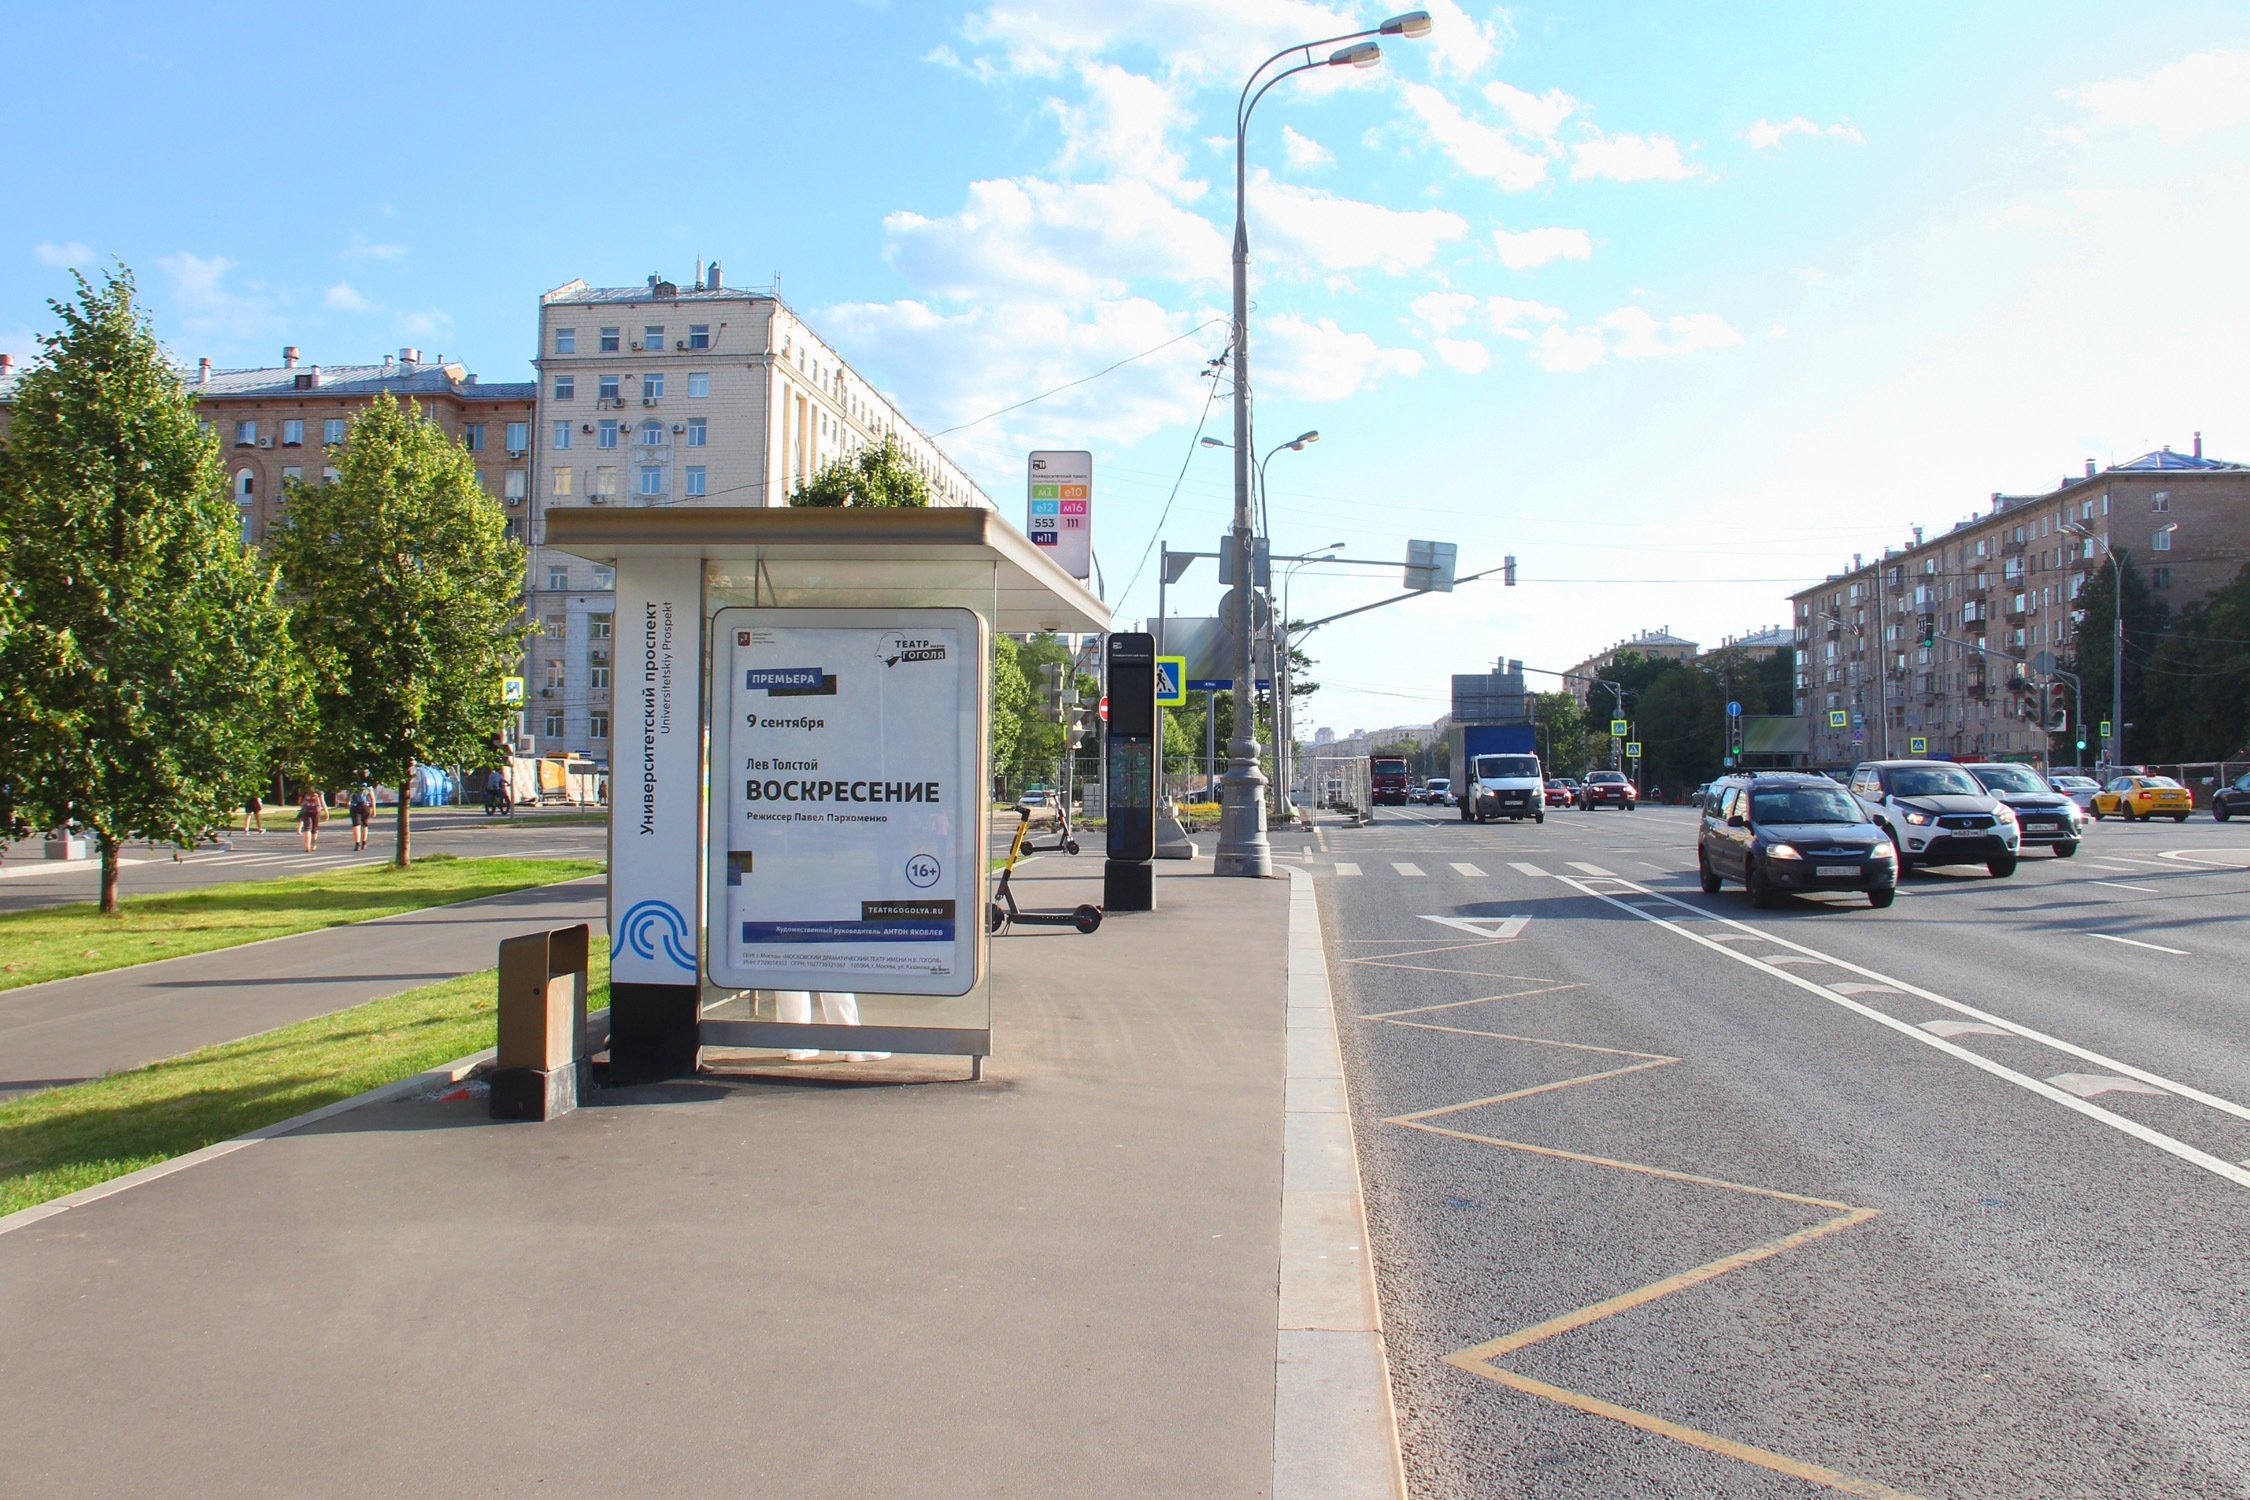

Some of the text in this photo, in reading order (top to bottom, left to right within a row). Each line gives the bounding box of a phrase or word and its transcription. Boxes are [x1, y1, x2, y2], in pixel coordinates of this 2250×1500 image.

[1035, 518, 1079, 528] 553 111
[895, 640, 929, 648] ТЕАТР
[902, 651, 944, 660] ГОГОЛЯ
[661, 601, 674, 734] Universitetskiy Prospekt
[752, 674, 815, 684] ПРЕМЬЕРА
[640, 602, 659, 836] Университетский проспект
[746, 713, 824, 731] 9 сентября
[746, 758, 818, 771] Лев Толстой
[746, 780, 940, 803] ВОСКРЕСЕНИЕ
[746, 812, 888, 824] Режиссер Павел Пархоменко
[911, 863, 937, 877] 16+
[868, 906, 944, 914] TEATRGOGOLYA.RU
[775, 925, 944, 936] Художественный руководитель АНТОН ЯКОВЛЕВ
